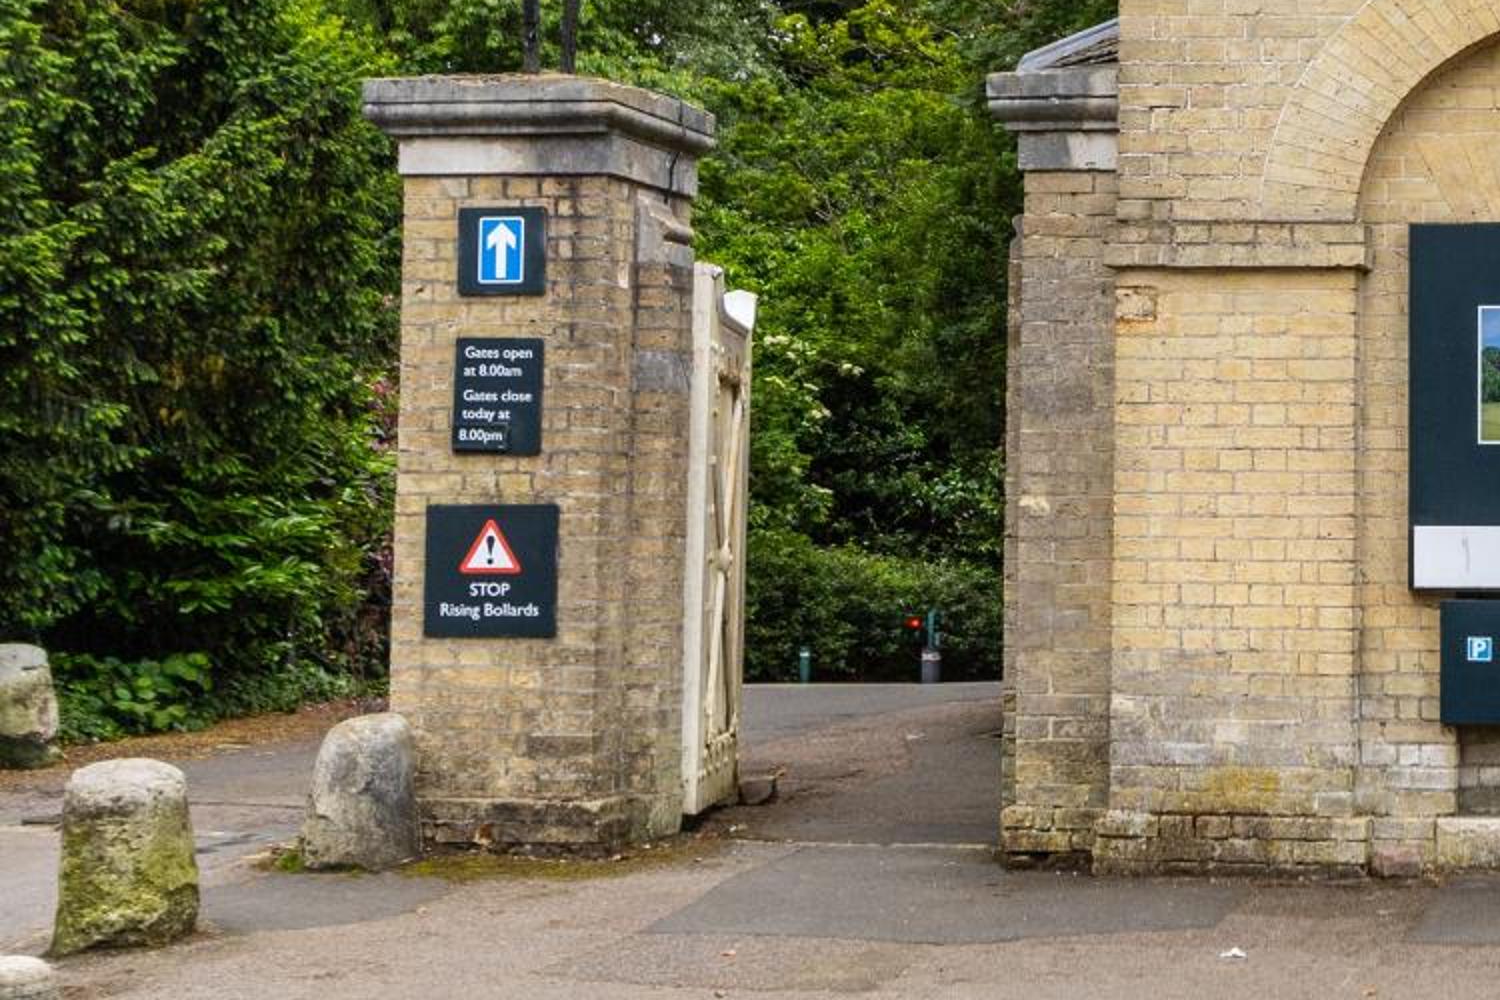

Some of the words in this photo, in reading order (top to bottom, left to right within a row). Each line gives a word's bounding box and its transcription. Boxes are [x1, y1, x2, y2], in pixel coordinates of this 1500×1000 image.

[464, 346, 500, 359] Gates
[502, 348, 533, 361] open
[463, 366, 477, 376] at
[478, 363, 523, 376] 8.00am
[463, 389, 499, 401] Gates
[501, 388, 533, 402] close
[462, 407, 496, 423] today
[498, 409, 511, 419] at
[458, 427, 503, 445] 8.00pm
[469, 582, 511, 597] STOP
[439, 602, 481, 621] Rising
[483, 602, 539, 617] Bollards
[1472, 640, 1486, 658] P
